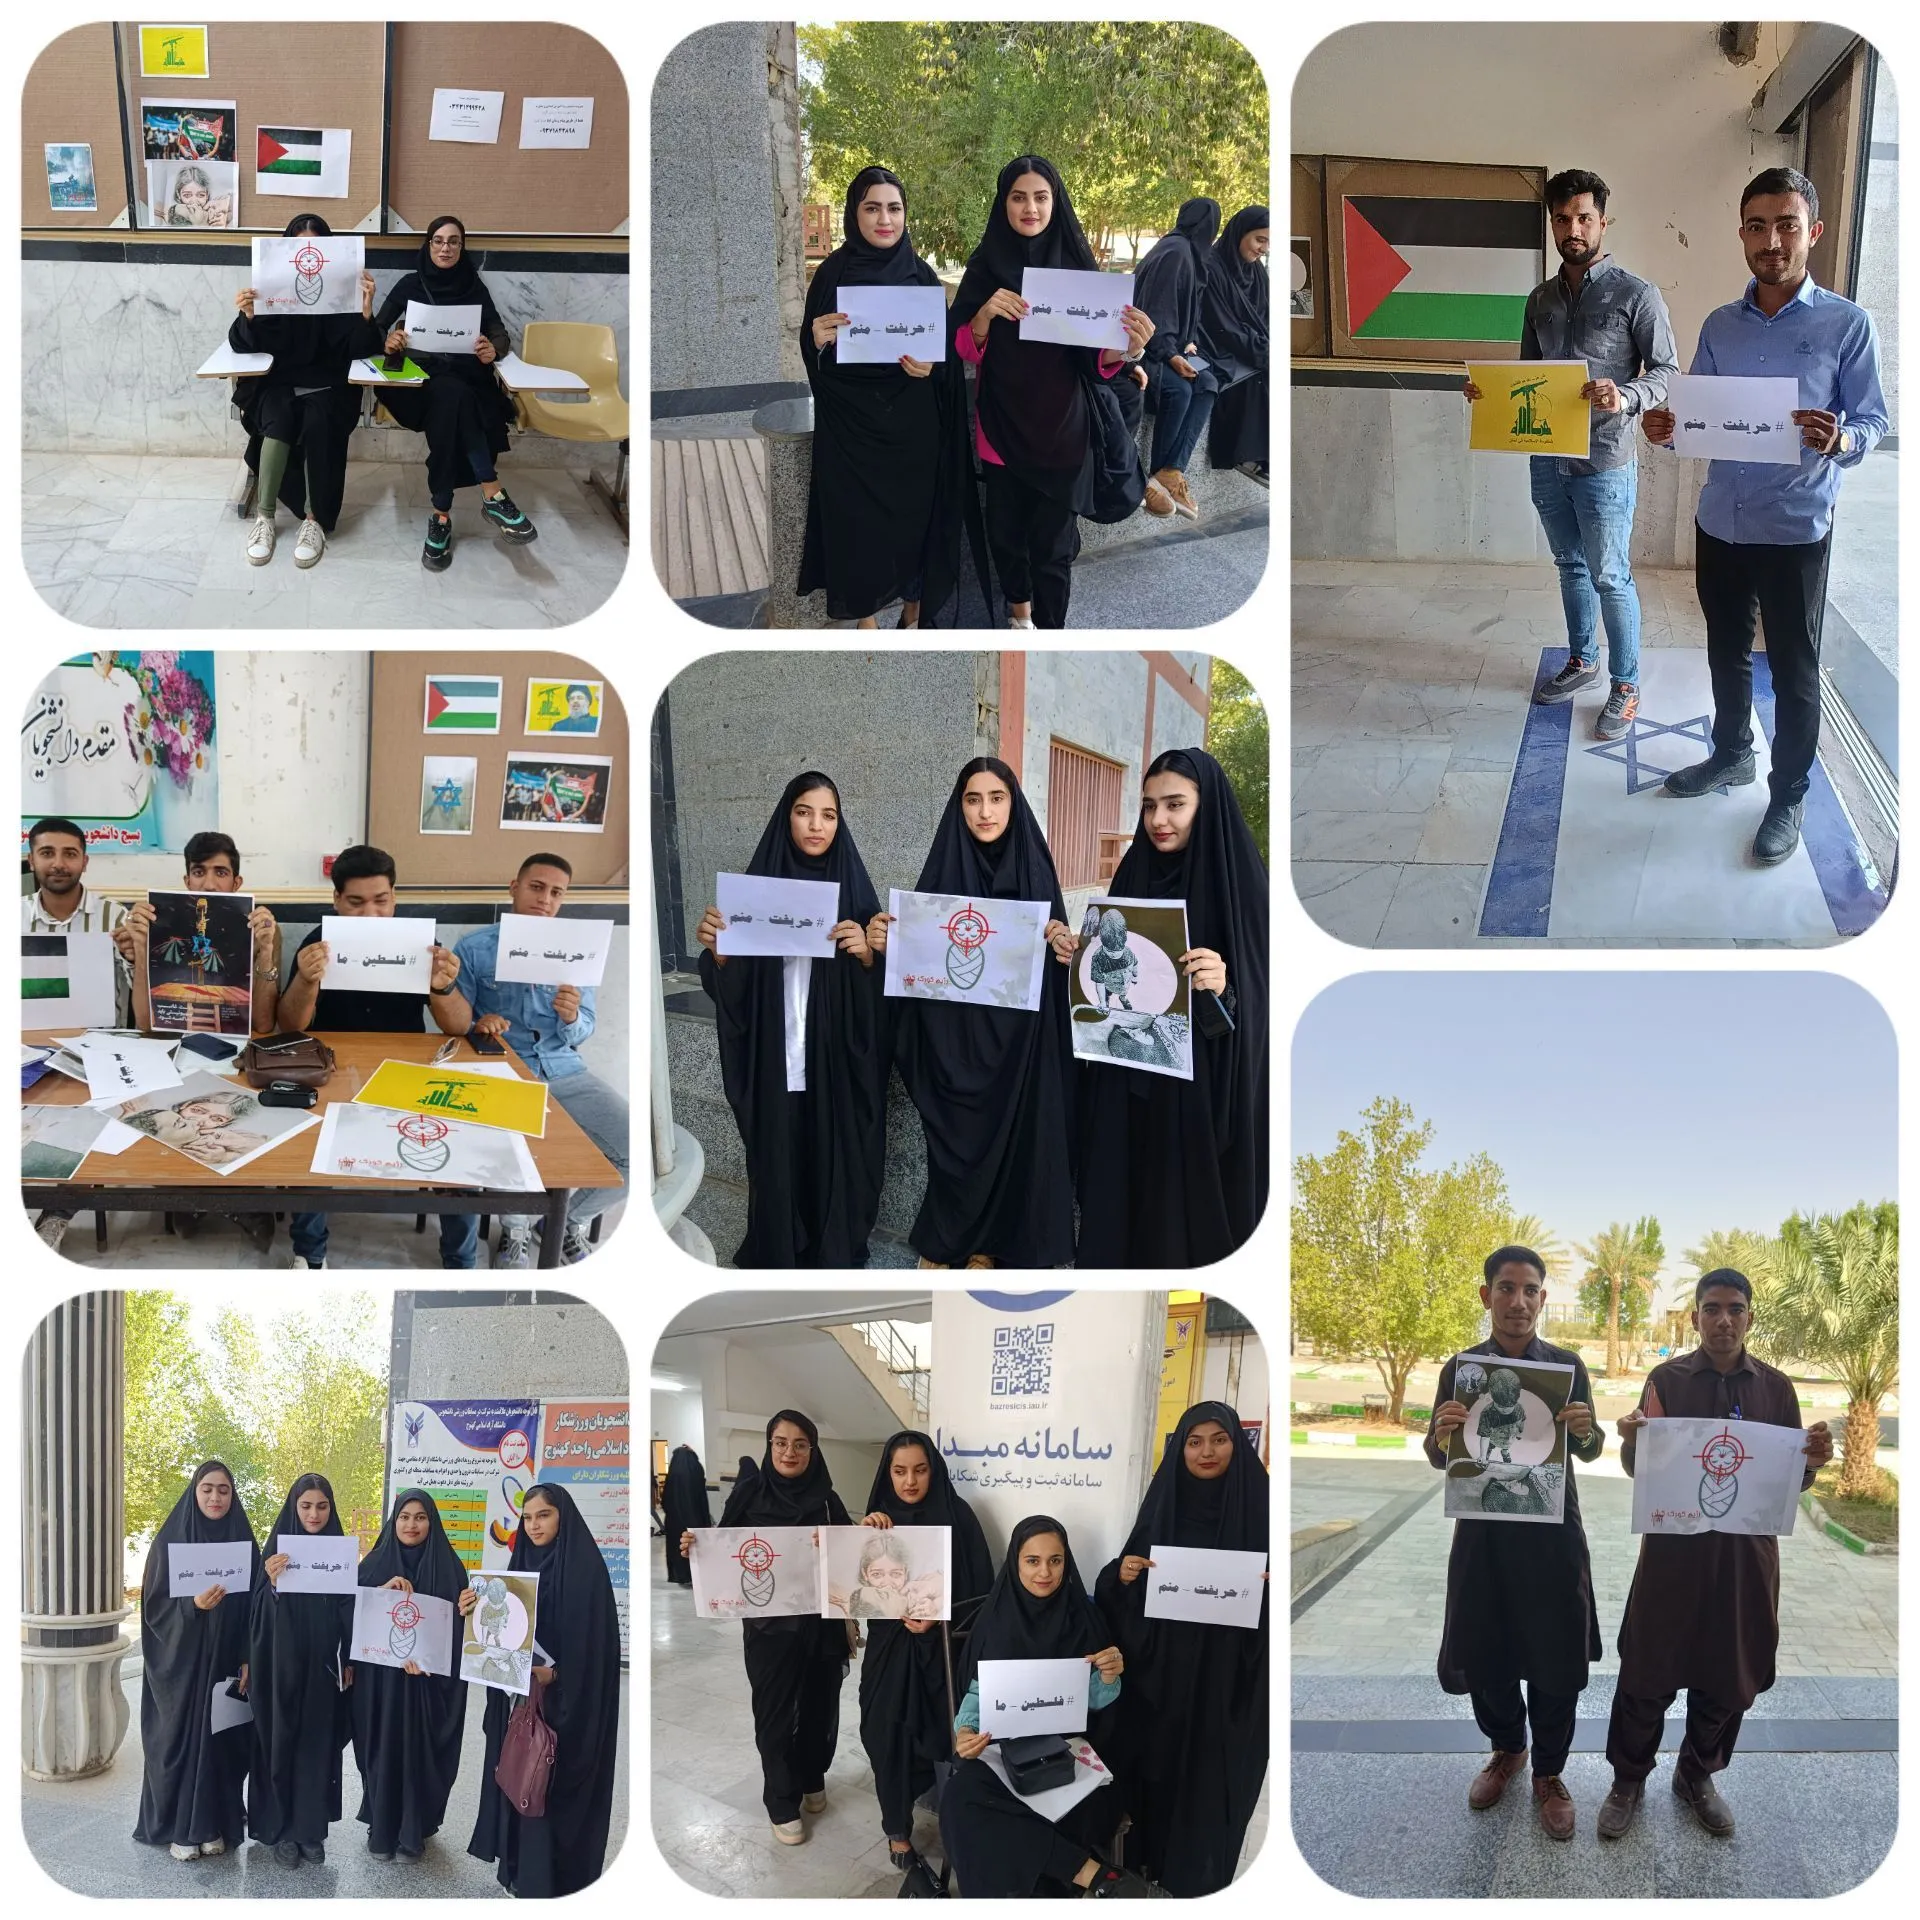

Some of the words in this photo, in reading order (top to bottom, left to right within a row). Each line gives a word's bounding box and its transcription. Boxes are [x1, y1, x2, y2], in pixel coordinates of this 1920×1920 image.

[1031, 303, 1052, 316] منم
[1066, 305, 1109, 320] حریفت
[436, 328, 465, 337] حریفت
[849, 324, 871, 338] منم
[885, 323, 925, 336] حریفت
[1683, 418, 1706, 432] منم
[1722, 419, 1772, 435] حریفت
[82, 726, 116, 761] مقدم
[85, 824, 118, 843] دانشجوی
[120, 826, 141, 845] بسیج
[730, 912, 753, 925] منم
[768, 914, 813, 929] حریفت
[337, 952, 348, 965] ما
[509, 947, 529, 960] منم
[543, 948, 585, 963] حریفت
[362, 954, 407, 968] فلسطین
[554, 1411, 589, 1432] ورزشکار
[544, 1440, 571, 1460] کهنوج
[571, 1440, 592, 1459] واحد
[592, 1440, 622, 1459] اسلامی
[936, 1426, 1010, 1468] مبدا
[1014, 1426, 1113, 1461] سامانه
[572, 1469, 589, 1481] دارای
[949, 1468, 979, 1484] شکایا
[979, 1470, 1024, 1489] پیگیری
[1034, 1474, 1060, 1490] ثبت
[1060, 1473, 1102, 1488] سامانه
[1026, 1476, 1032, 1489] و
[204, 1567, 236, 1578] حریفت
[286, 1561, 301, 1572] منم
[311, 1561, 342, 1573] حریفت
[178, 1570, 195, 1581] منم
[1158, 1582, 1180, 1595] منم
[1194, 1585, 1238, 1599] حریفت
[995, 1699, 1007, 1712] ما
[1021, 1695, 1065, 1712] فلسطین
